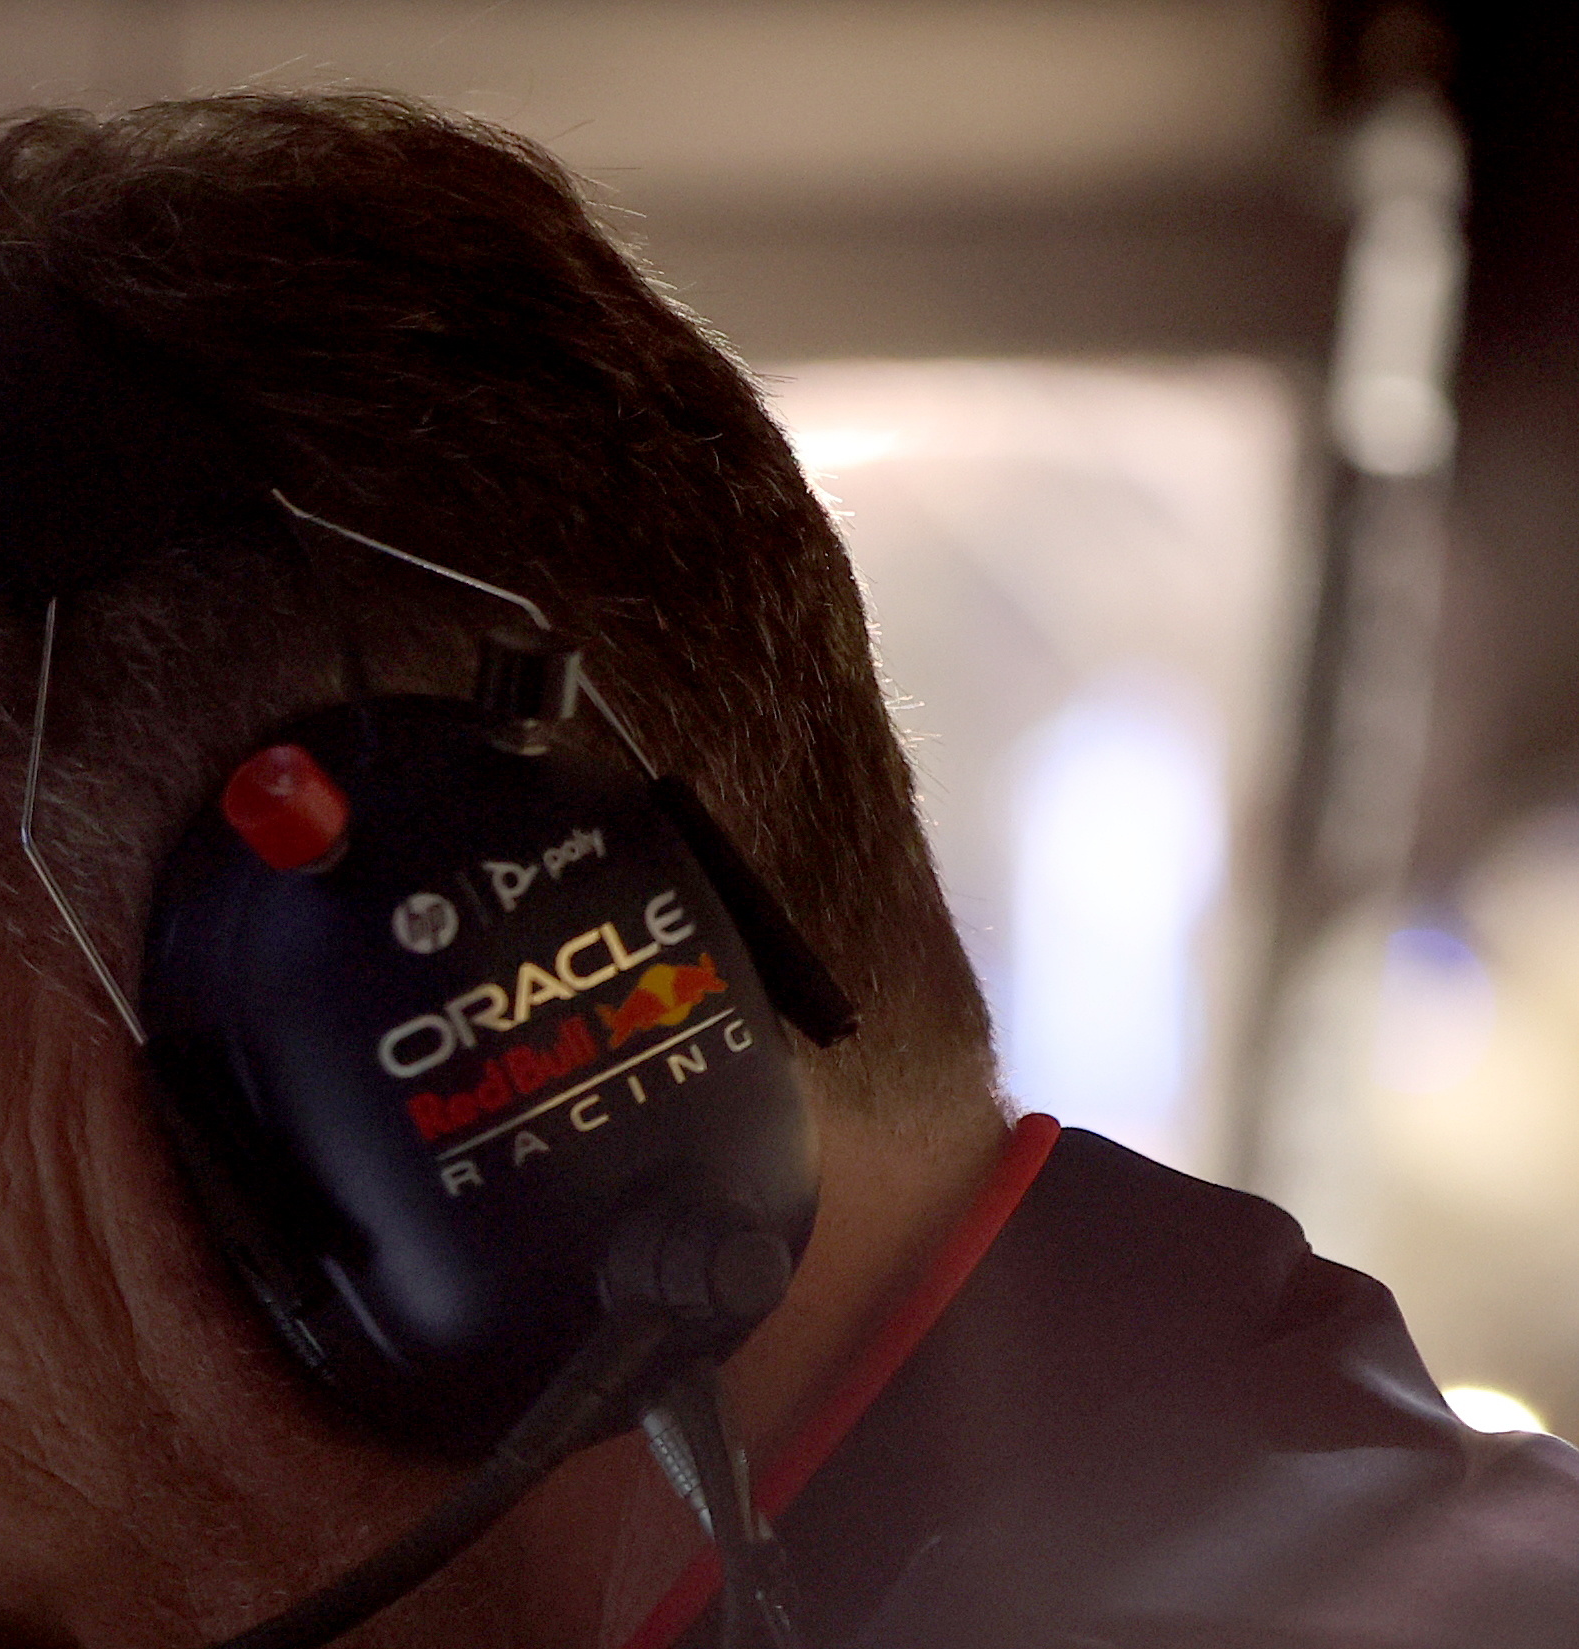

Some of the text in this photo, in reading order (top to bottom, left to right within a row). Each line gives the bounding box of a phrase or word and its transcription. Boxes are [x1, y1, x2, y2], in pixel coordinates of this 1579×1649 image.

[377, 889, 696, 1080] ORACLE
[407, 1016, 599, 1145] Red Bull
[440, 1018, 754, 1198] RACING
